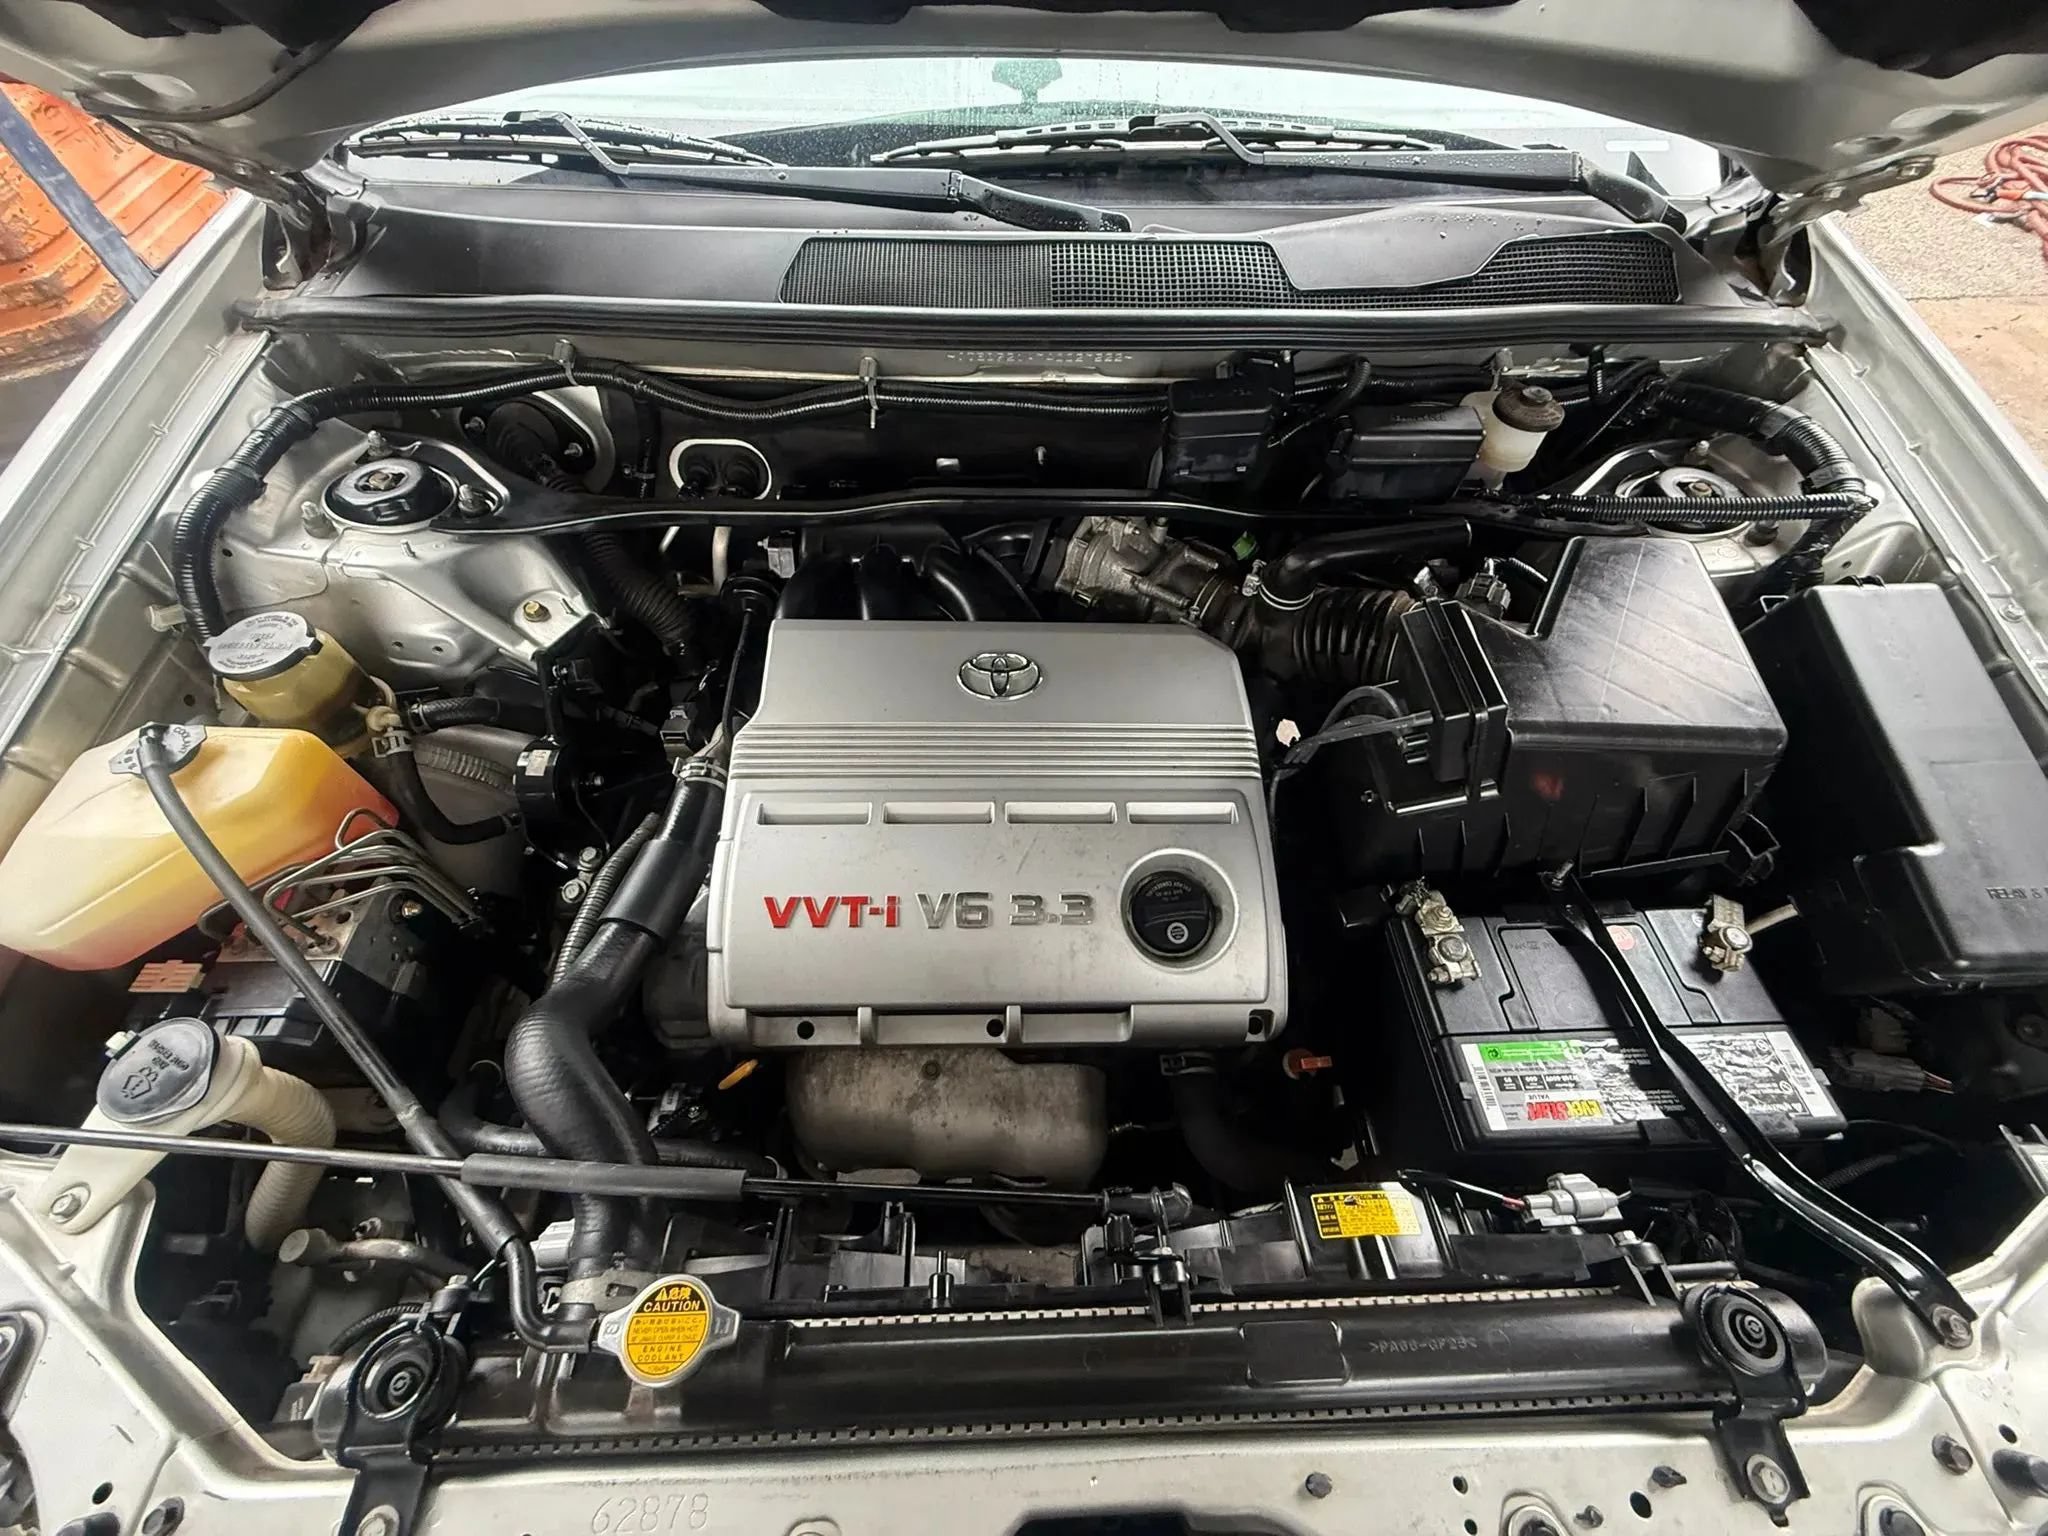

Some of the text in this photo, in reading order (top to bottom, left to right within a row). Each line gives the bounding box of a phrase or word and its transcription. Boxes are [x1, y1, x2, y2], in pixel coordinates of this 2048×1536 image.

[763, 890, 1095, 930] VVT-i V6 3.3
[642, 1300, 701, 1312] CAUTION
[637, 1353, 684, 1362] COOLANT
[590, 1492, 709, 1535] 62878
